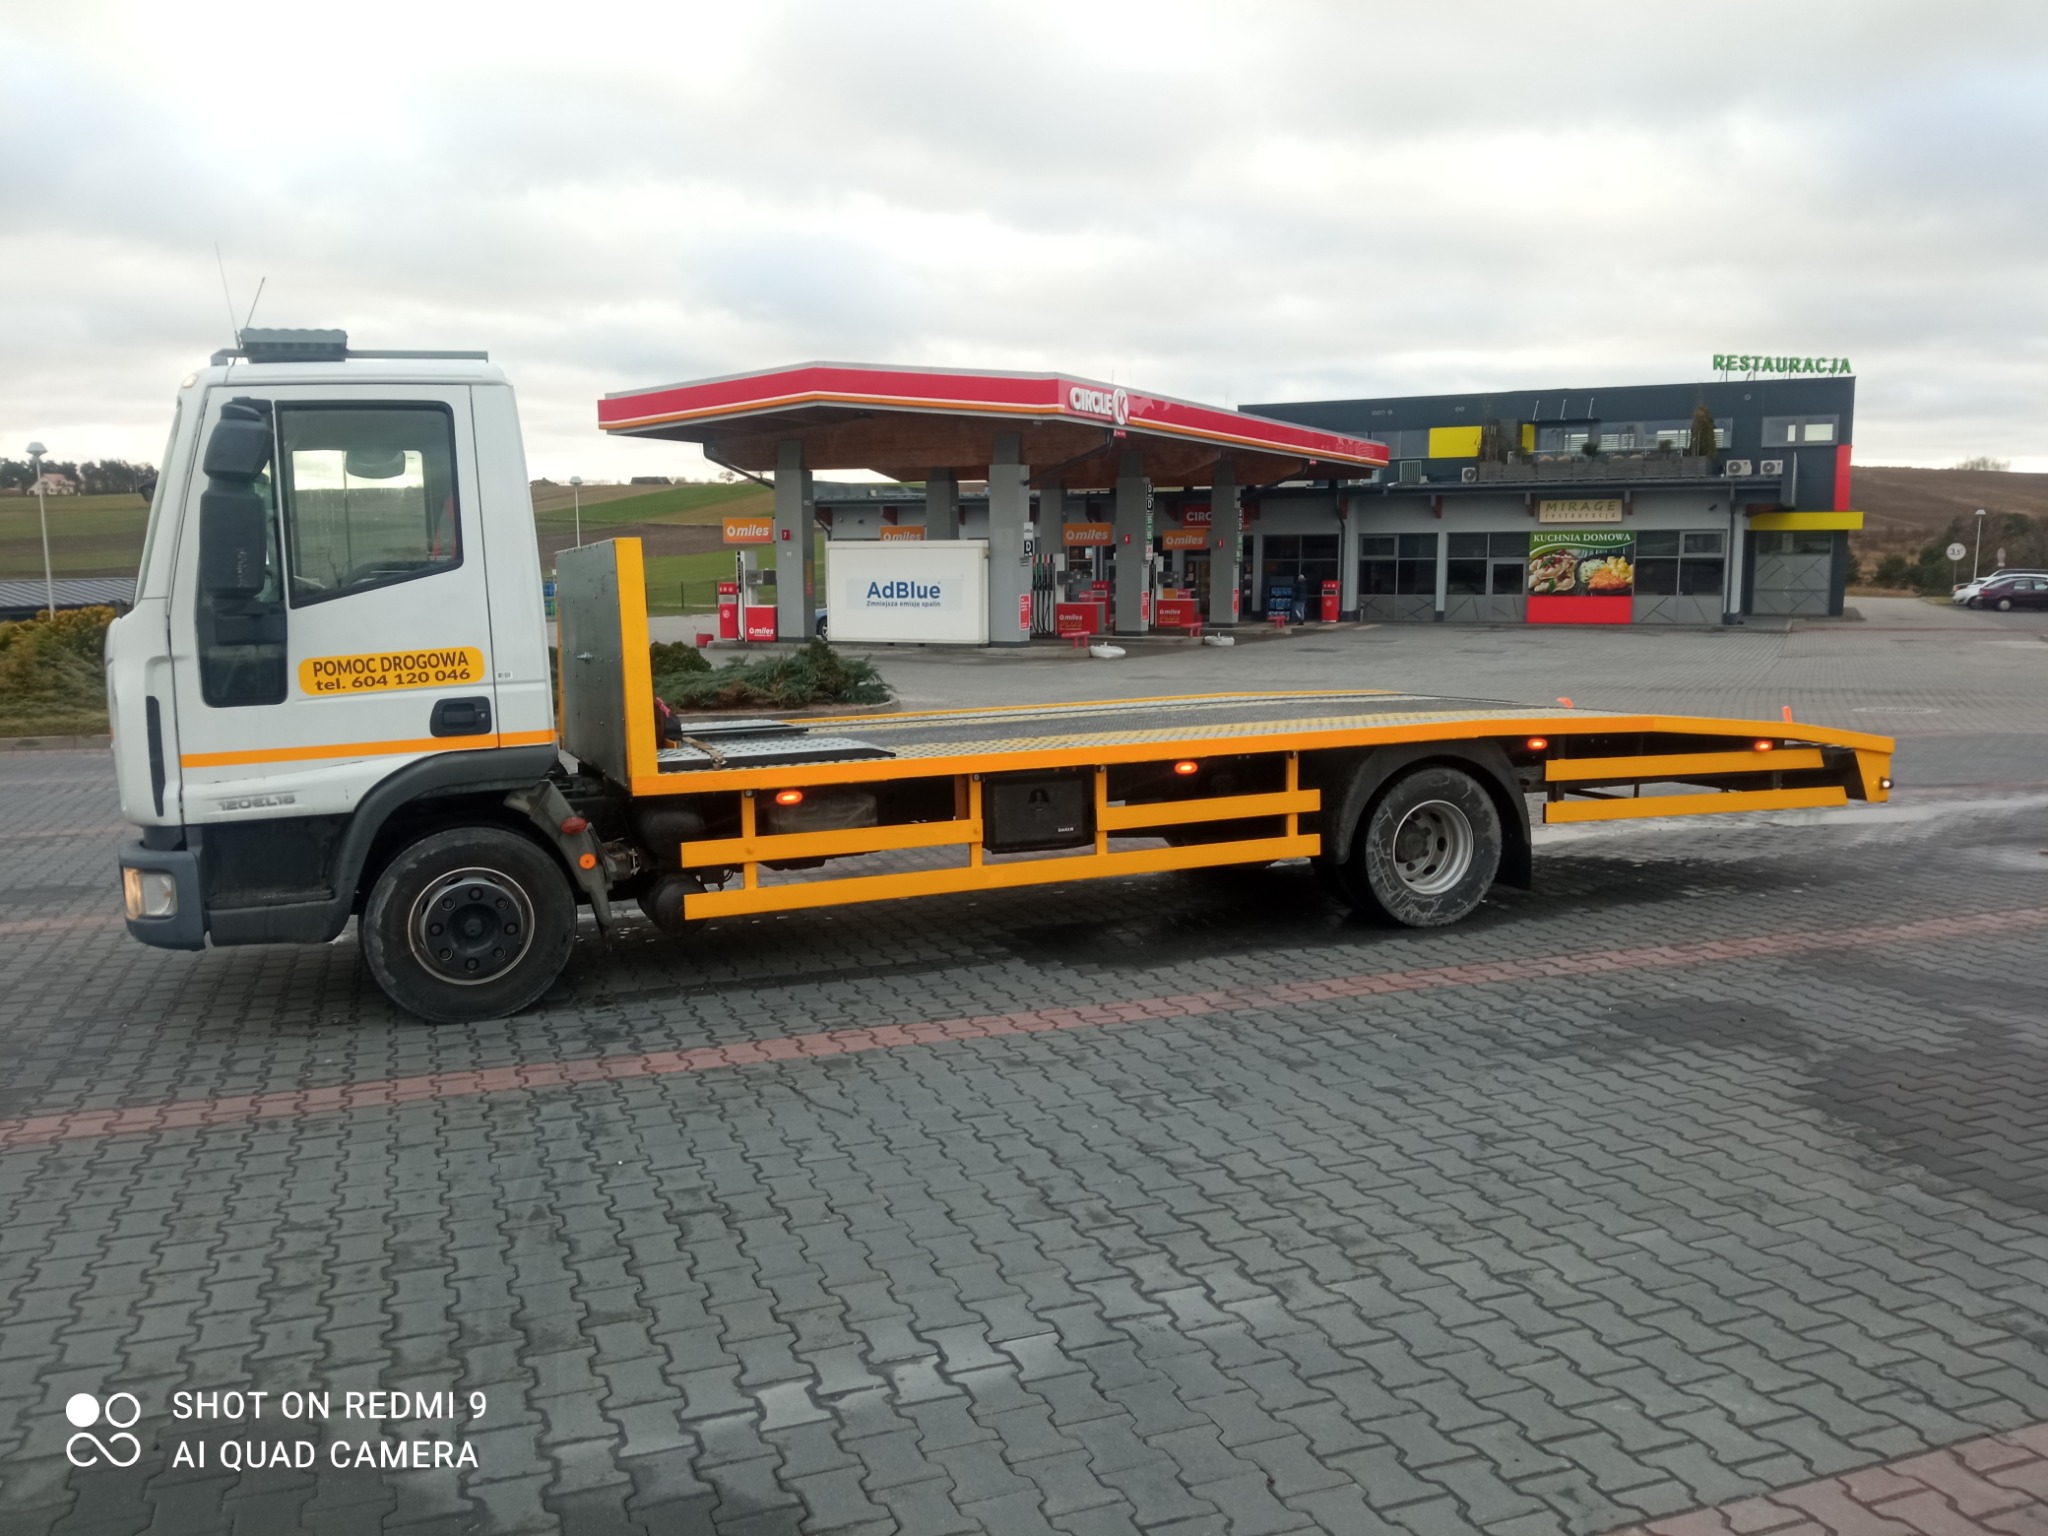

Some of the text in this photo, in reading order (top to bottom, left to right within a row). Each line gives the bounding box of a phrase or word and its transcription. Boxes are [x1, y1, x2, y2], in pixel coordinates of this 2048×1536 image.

[1713, 354, 1852, 374] RESTAURACJA
[1070, 387, 1113, 416] CIRCLE
[1546, 501, 1616, 512] MIRAGE
[1545, 512, 1616, 520] restauracja
[1533, 533, 1631, 542] KUCHNIA DOMOWA
[867, 581, 941, 599] AdBlue
[866, 600, 898, 608] Zmniejsza
[313, 651, 469, 677] POMOC DROGOWA
[315, 668, 471, 691] tel. 604 120 046
